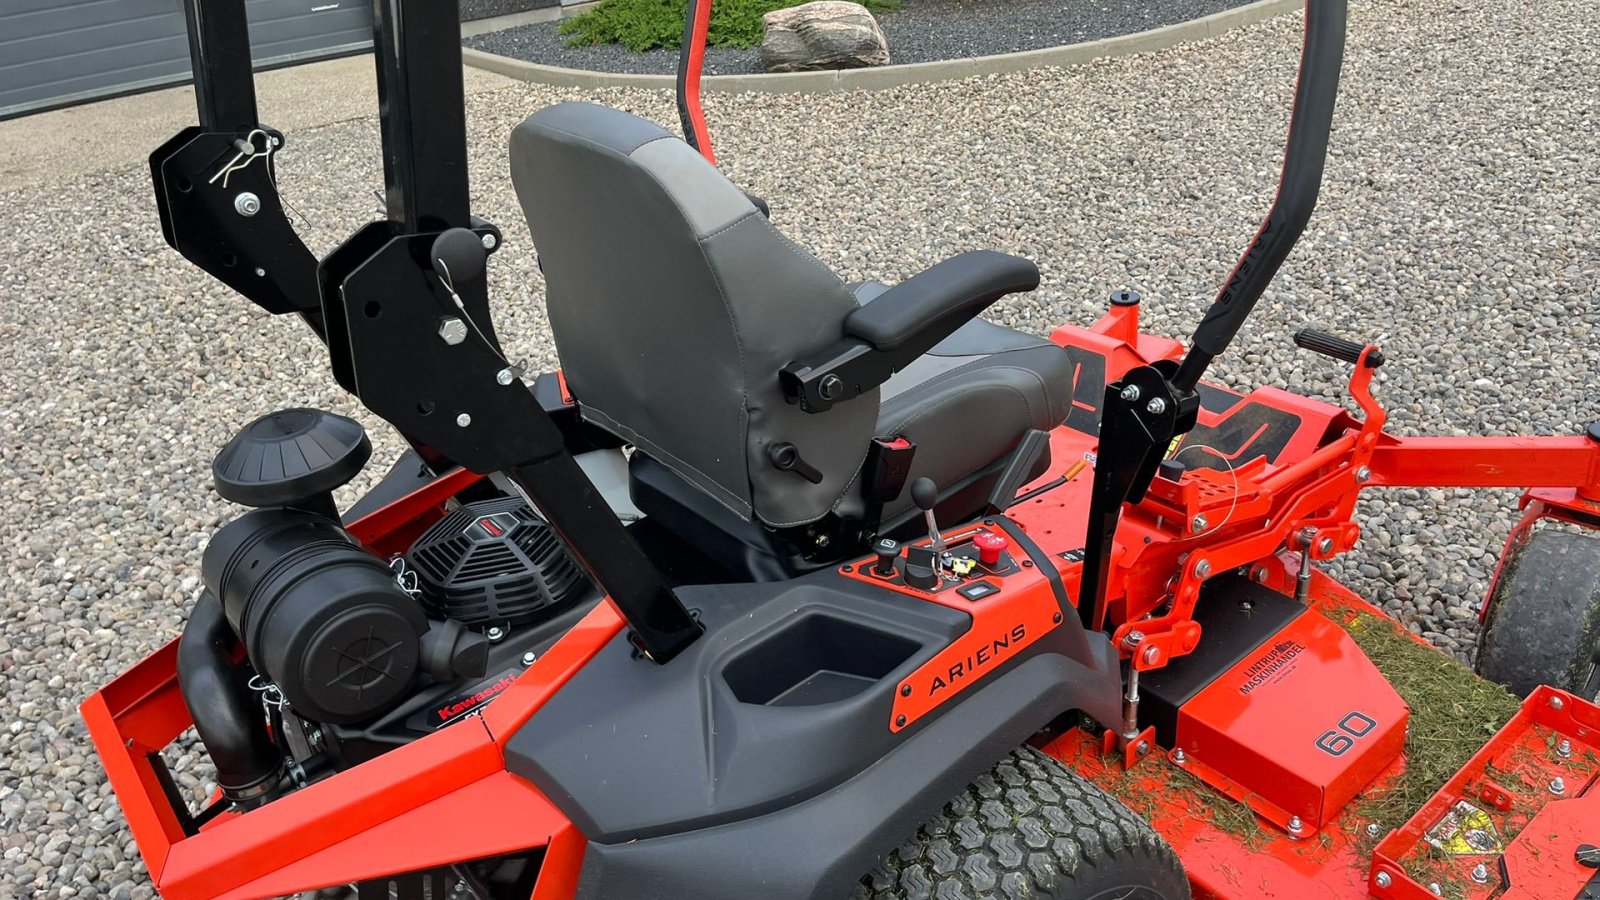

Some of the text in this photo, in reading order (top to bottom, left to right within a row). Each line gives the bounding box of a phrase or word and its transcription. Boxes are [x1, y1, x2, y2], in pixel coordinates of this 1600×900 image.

[929, 623, 1026, 696] ARIENS
[1239, 644, 1306, 695] MASKINHANDEL
[1243, 649, 1279, 678] LINTRUP
[438, 673, 517, 720] Kawasaki
[1315, 709, 1378, 757] 60
